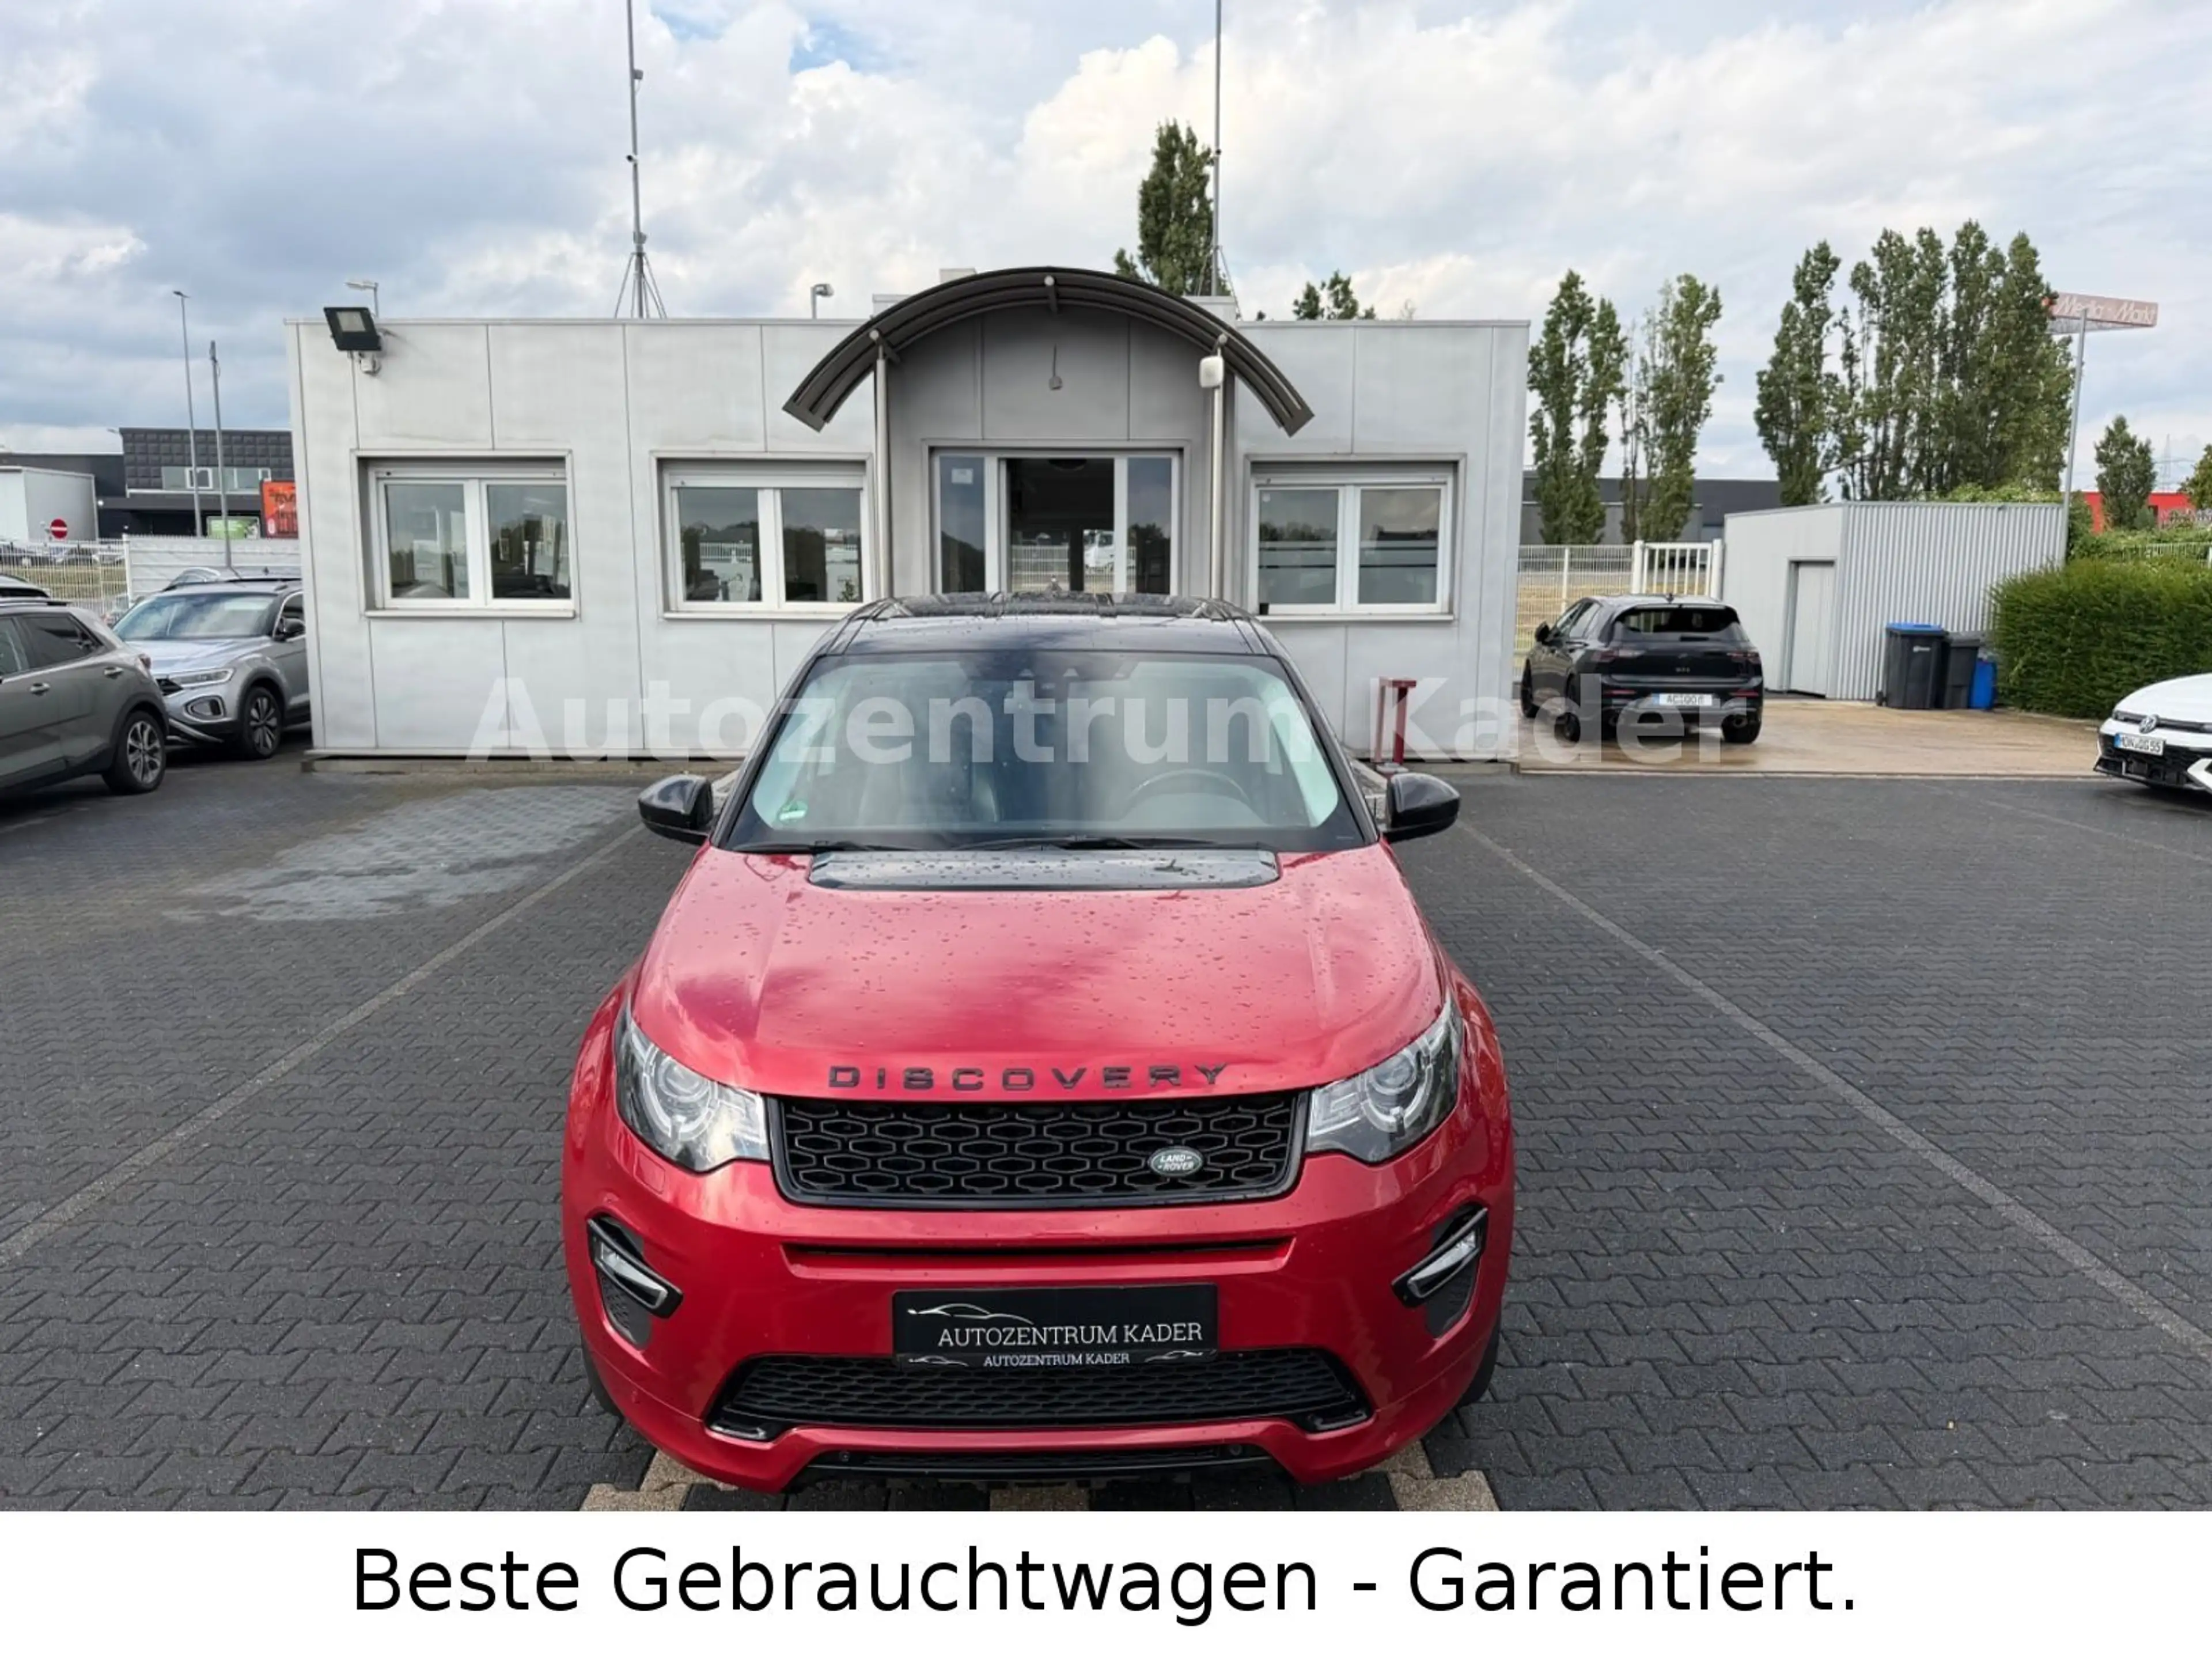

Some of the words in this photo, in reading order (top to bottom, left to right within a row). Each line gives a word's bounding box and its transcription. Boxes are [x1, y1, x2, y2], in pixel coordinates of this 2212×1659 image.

[828, 1062, 1228, 1090] DISCOVERY
[938, 1325, 1118, 1347] AUTOZENTRUM
[1123, 1322, 1203, 1343] KADER
[983, 1353, 1082, 1368] AUTOZENTRUM
[1085, 1353, 1130, 1365] KADER
